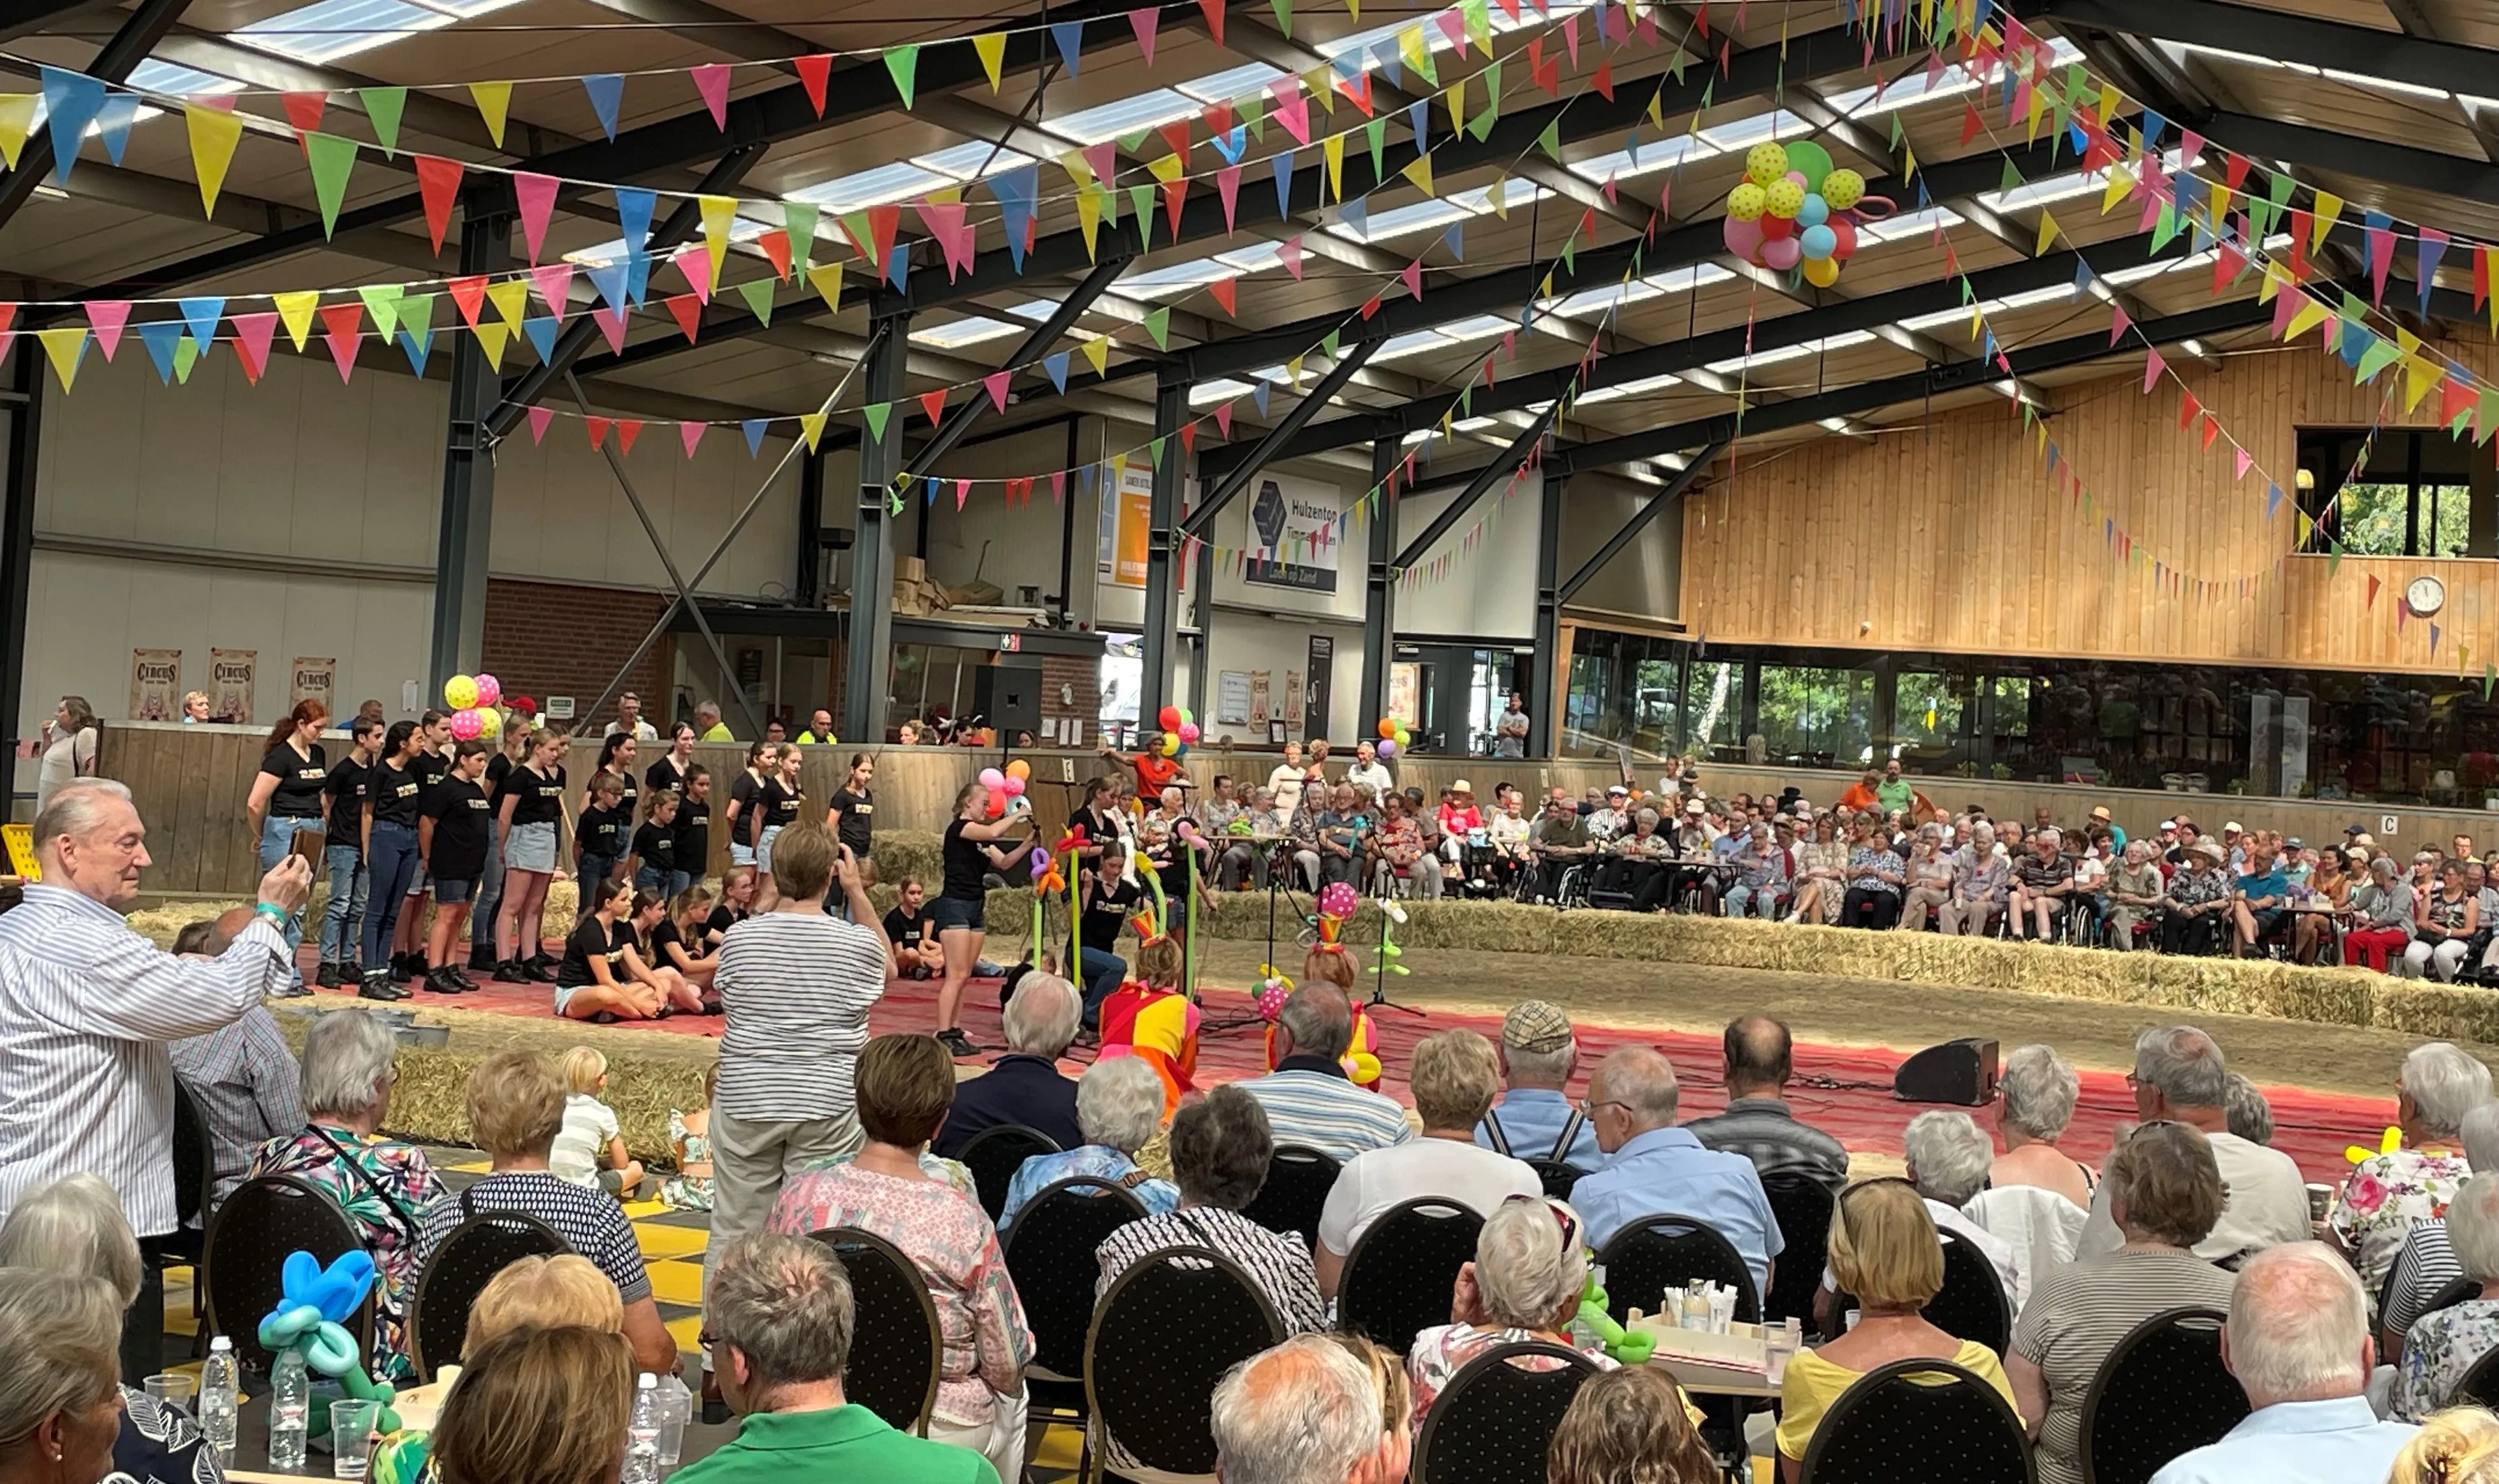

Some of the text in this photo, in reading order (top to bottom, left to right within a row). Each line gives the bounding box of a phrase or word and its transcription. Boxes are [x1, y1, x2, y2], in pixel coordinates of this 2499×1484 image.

[1292, 499, 1337, 526] Hulzentop
[137, 662, 176, 682] CIRCUS
[214, 662, 251, 682] CIRCUS
[297, 670, 331, 688] CIRCUS
[2385, 817, 2394, 831] C
